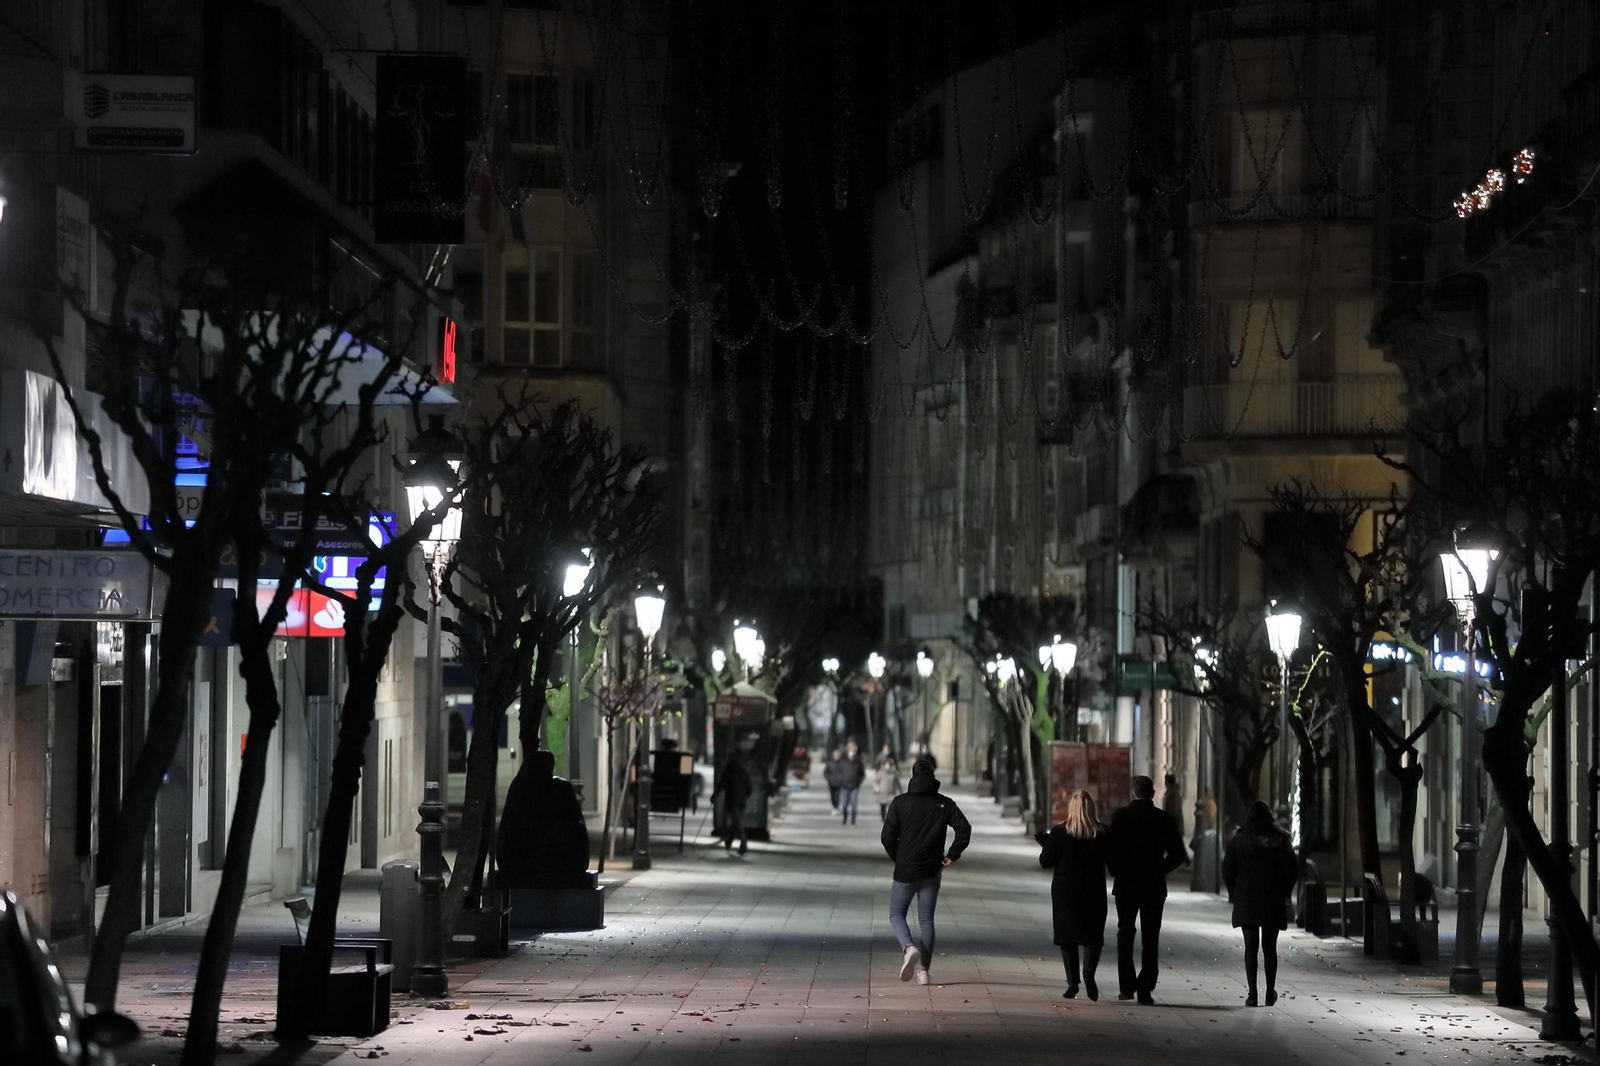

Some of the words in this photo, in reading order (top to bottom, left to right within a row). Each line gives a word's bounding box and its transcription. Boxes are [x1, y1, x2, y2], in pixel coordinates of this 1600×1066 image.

[113, 91, 193, 102] CASABLANCA
[158, 129, 184, 137] FINCAS
[316, 540, 364, 549] Asesores
[0, 556, 116, 578] CENTRO
